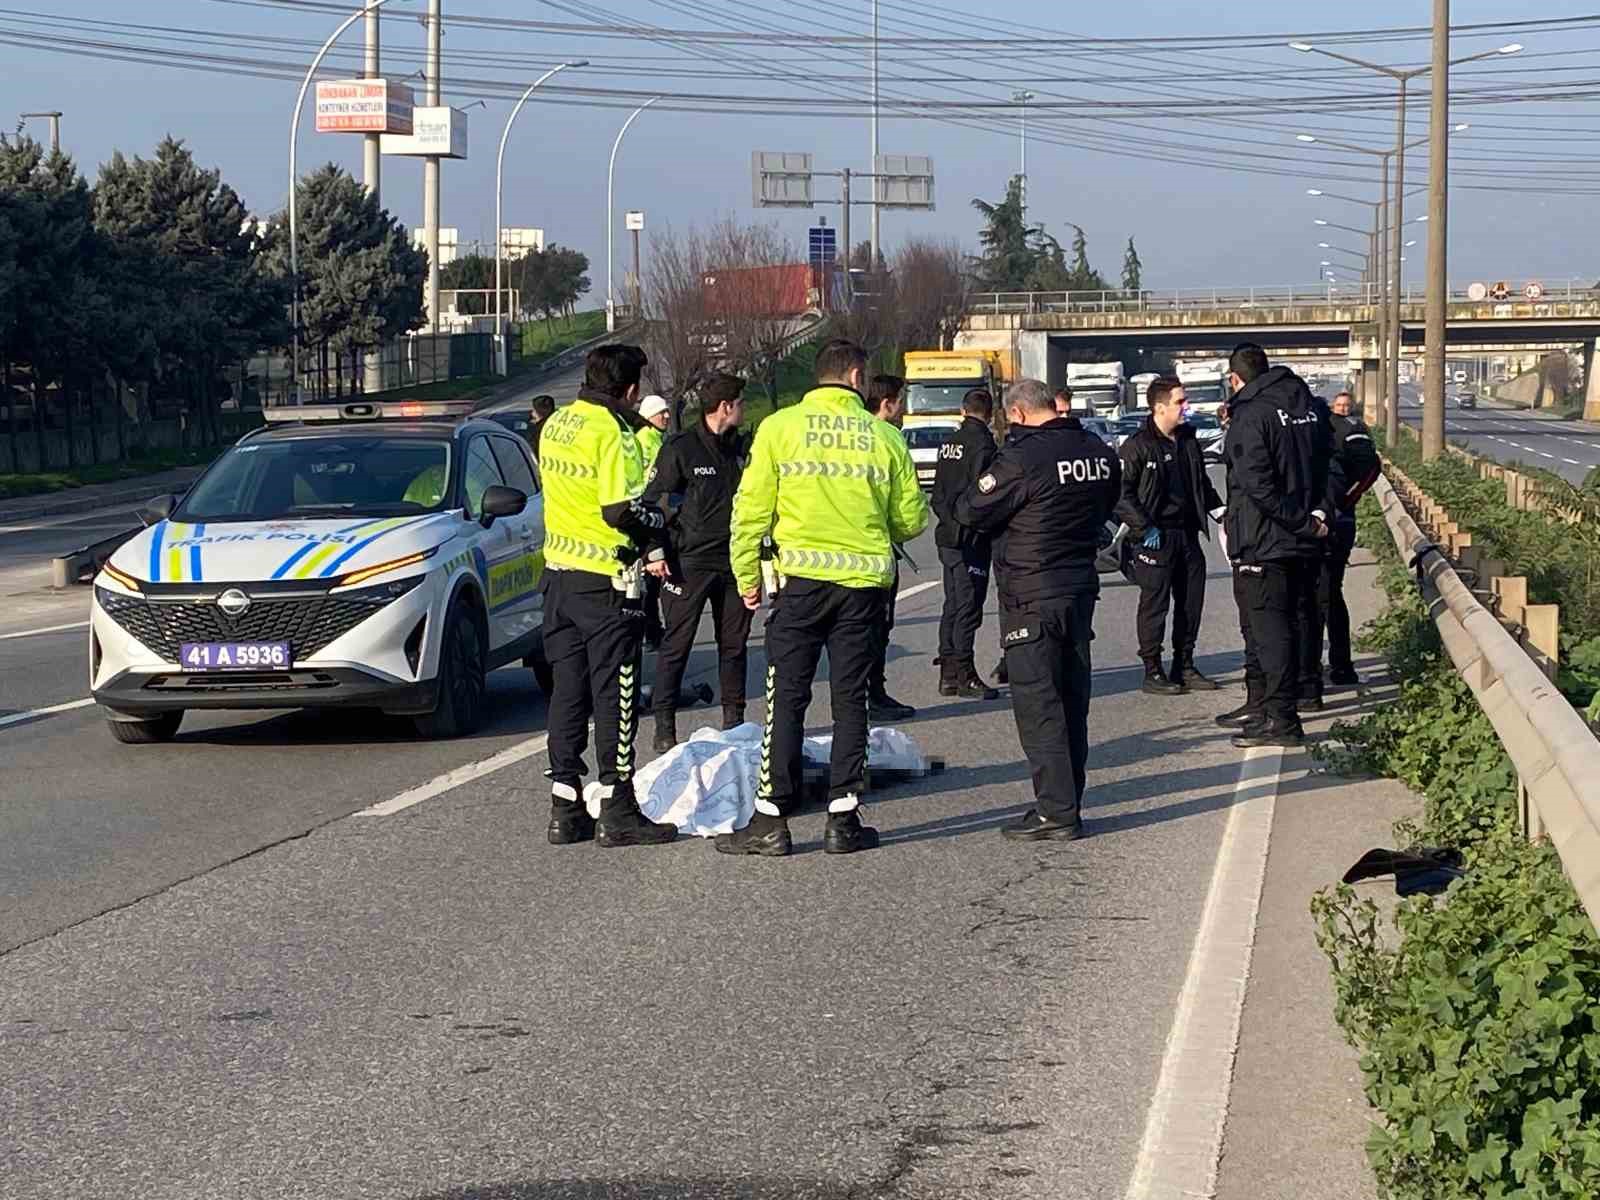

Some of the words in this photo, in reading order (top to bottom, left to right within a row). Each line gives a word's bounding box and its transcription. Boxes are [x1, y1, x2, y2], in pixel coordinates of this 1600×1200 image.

[1056, 457, 1111, 484] POLİS
[188, 647, 210, 666] 41
[217, 648, 237, 666] A
[237, 646, 284, 664] 5936
